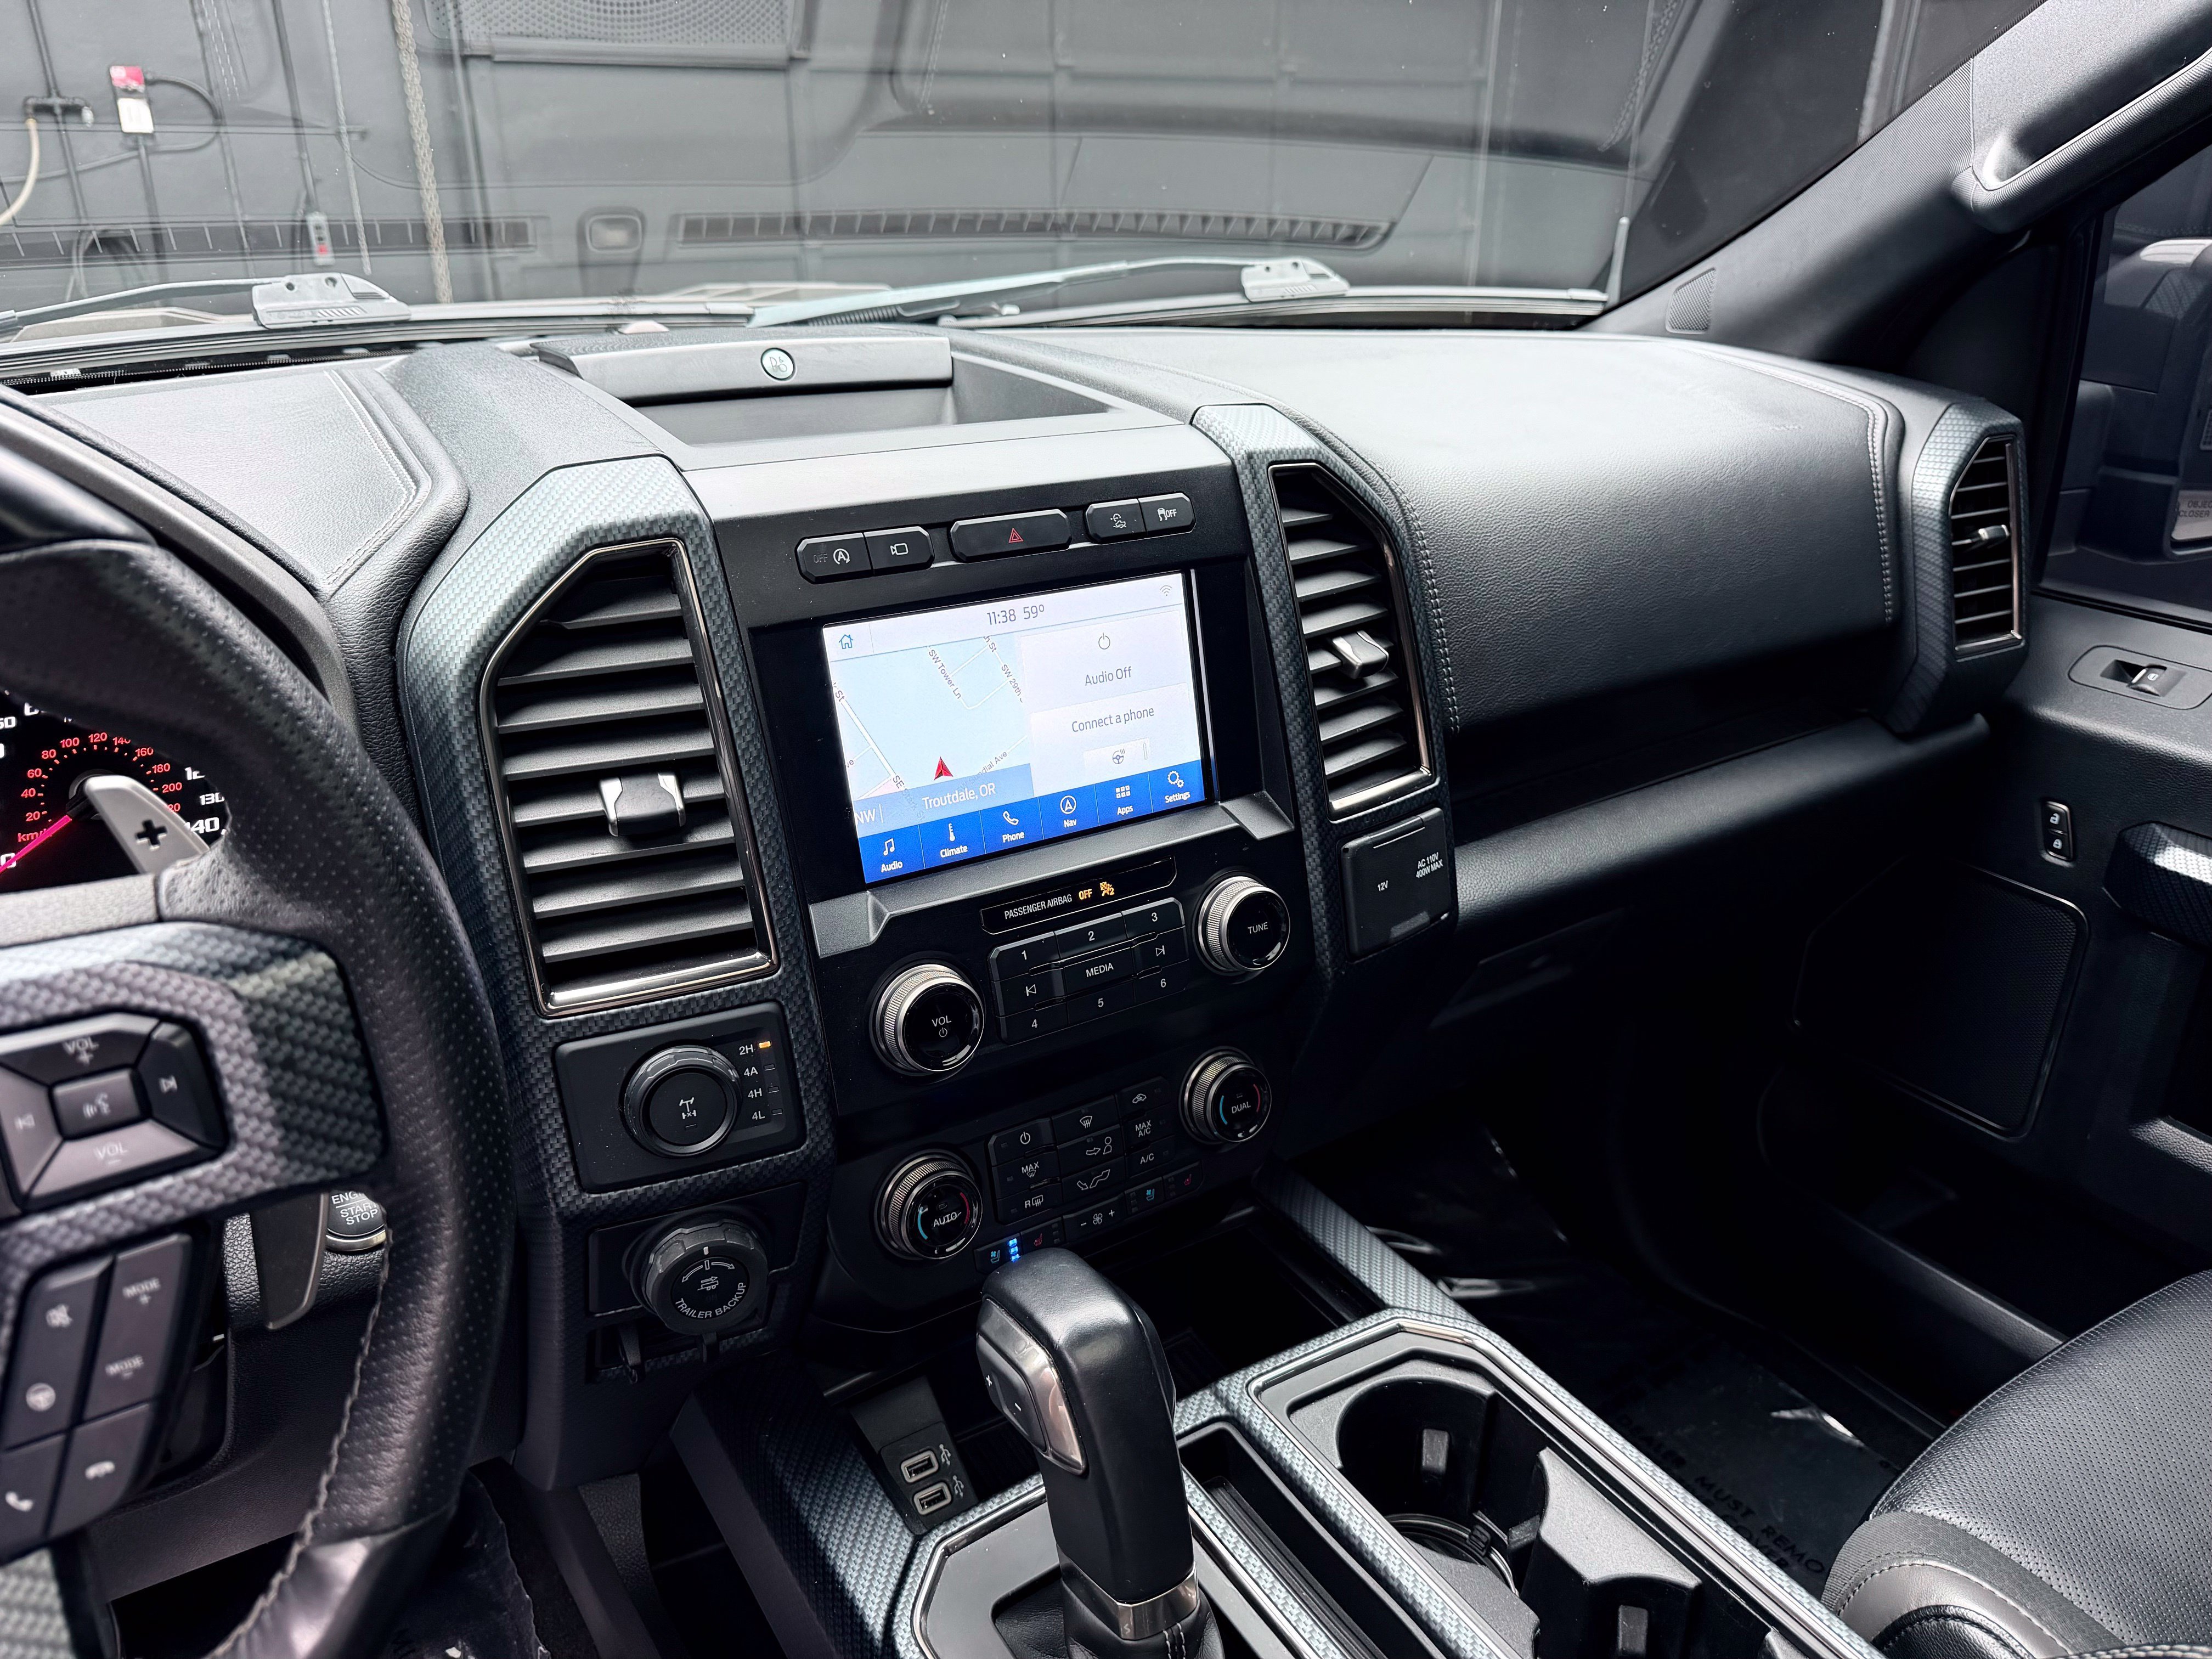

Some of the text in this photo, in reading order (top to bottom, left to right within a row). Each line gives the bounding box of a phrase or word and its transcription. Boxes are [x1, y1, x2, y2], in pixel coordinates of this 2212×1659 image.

[1165, 509, 1177, 518] OFF
[813, 553, 828, 563] OFF
[986, 608, 1017, 625] 11:38
[929, 649, 962, 699] SW Tower Ln
[1085, 666, 1132, 686] Audio Off
[1001, 664, 1013, 679] SW
[1008, 678, 1022, 697] 29th
[1071, 707, 1154, 732] Connect a phone
[60, 737, 80, 748] 100
[88, 732, 108, 743] 120
[41, 749, 57, 759] 80
[135, 747, 154, 757] 160
[994, 751, 1008, 764] Ave
[27, 768, 42, 778] 60
[152, 763, 171, 774] 180
[162, 782, 183, 793] 200
[893, 775, 905, 789] SE
[21, 788, 36, 798] 40
[921, 782, 996, 810] Troutdale, OR
[1164, 791, 1190, 804] Settings
[26, 811, 41, 822] 20
[855, 808, 876, 825] NW
[1116, 805, 1133, 816] Apps
[1063, 819, 1077, 828] Nav
[1002, 831, 1025, 843] Phone
[940, 845, 968, 859] Climate
[1417, 851, 1439, 869] AC 110V
[881, 860, 903, 873] Audio
[1415, 859, 1443, 878] 400W MAX
[1377, 880, 1389, 891] 12V
[1004, 888, 1093, 919] PASSENGER AIRBAG OFF
[1151, 912, 1158, 922] 3
[1247, 921, 1269, 935] TUNE
[1088, 930, 1095, 941] 2
[1021, 950, 1028, 960] 1
[1086, 962, 1114, 978] MEDIA
[1160, 978, 1166, 988] 6
[1098, 998, 1104, 1008] 5
[931, 1015, 952, 1026] VOL
[1031, 1019, 1038, 1029] 4
[63, 1036, 99, 1056] VOL
[738, 1043, 754, 1056] 2H
[743, 1066, 759, 1077] 4A
[748, 1087, 763, 1098] 4H
[1231, 1101, 1251, 1114] DUAL
[752, 1110, 765, 1120] 4L
[1135, 1120, 1152, 1132] MAX
[1138, 1127, 1152, 1138] A/C
[94, 1142, 128, 1160] VOL
[1140, 1153, 1155, 1165] A/C
[1021, 1161, 1040, 1174] MAX
[1024, 1200, 1031, 1209] R
[346, 1209, 378, 1225] STOP
[933, 1211, 957, 1228] AUTO
[123, 1278, 161, 1298] MODE
[675, 1282, 747, 1318] TRAILER BACKUP
[105, 1355, 145, 1375] MODE
[1694, 1476, 1756, 1518] MUST
